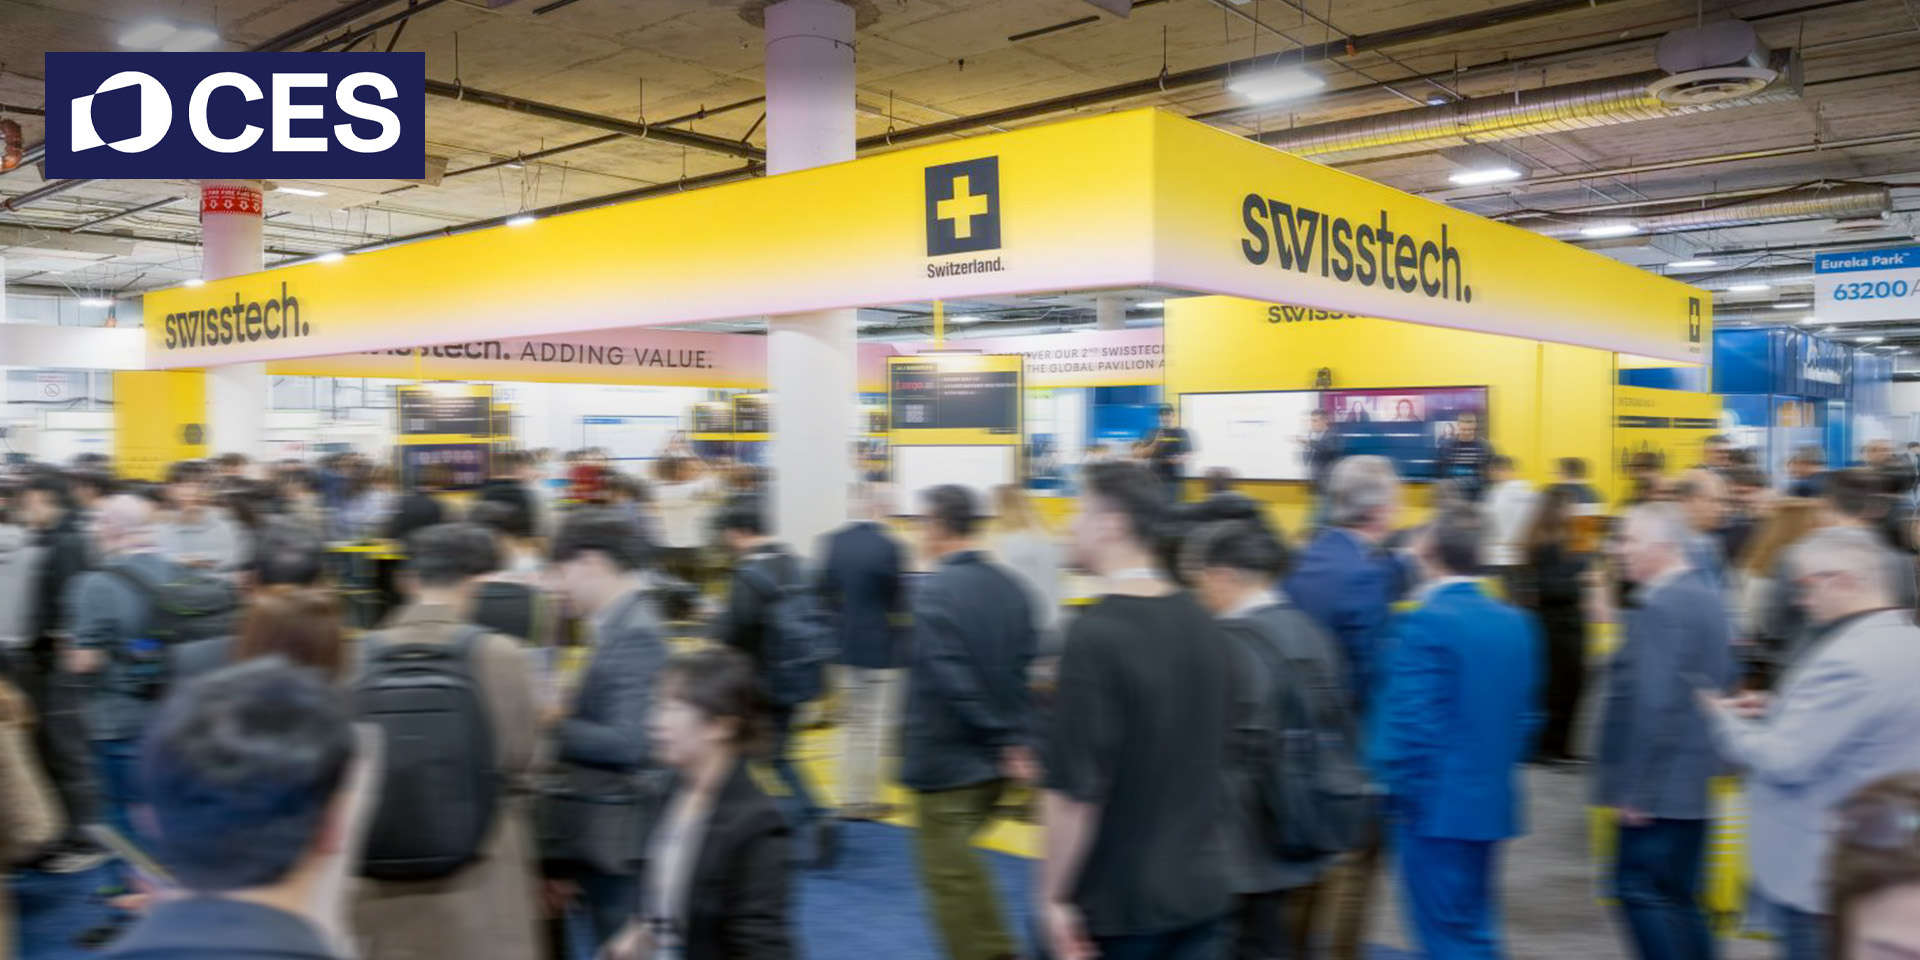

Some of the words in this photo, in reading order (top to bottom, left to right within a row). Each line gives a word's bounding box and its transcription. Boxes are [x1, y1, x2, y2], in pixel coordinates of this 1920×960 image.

[1241, 193, 1473, 304] swisstech.
[926, 256, 1005, 279] Switzerland.
[1821, 256, 1868, 270] Eureka
[1833, 280, 1908, 301] 63200
[165, 281, 310, 350] swisstech.
[520, 341, 624, 366] ADDING
[633, 346, 713, 369] VALUE.
[1049, 360, 1095, 373] GLOBAL
[1098, 359, 1155, 371] PAVILION
